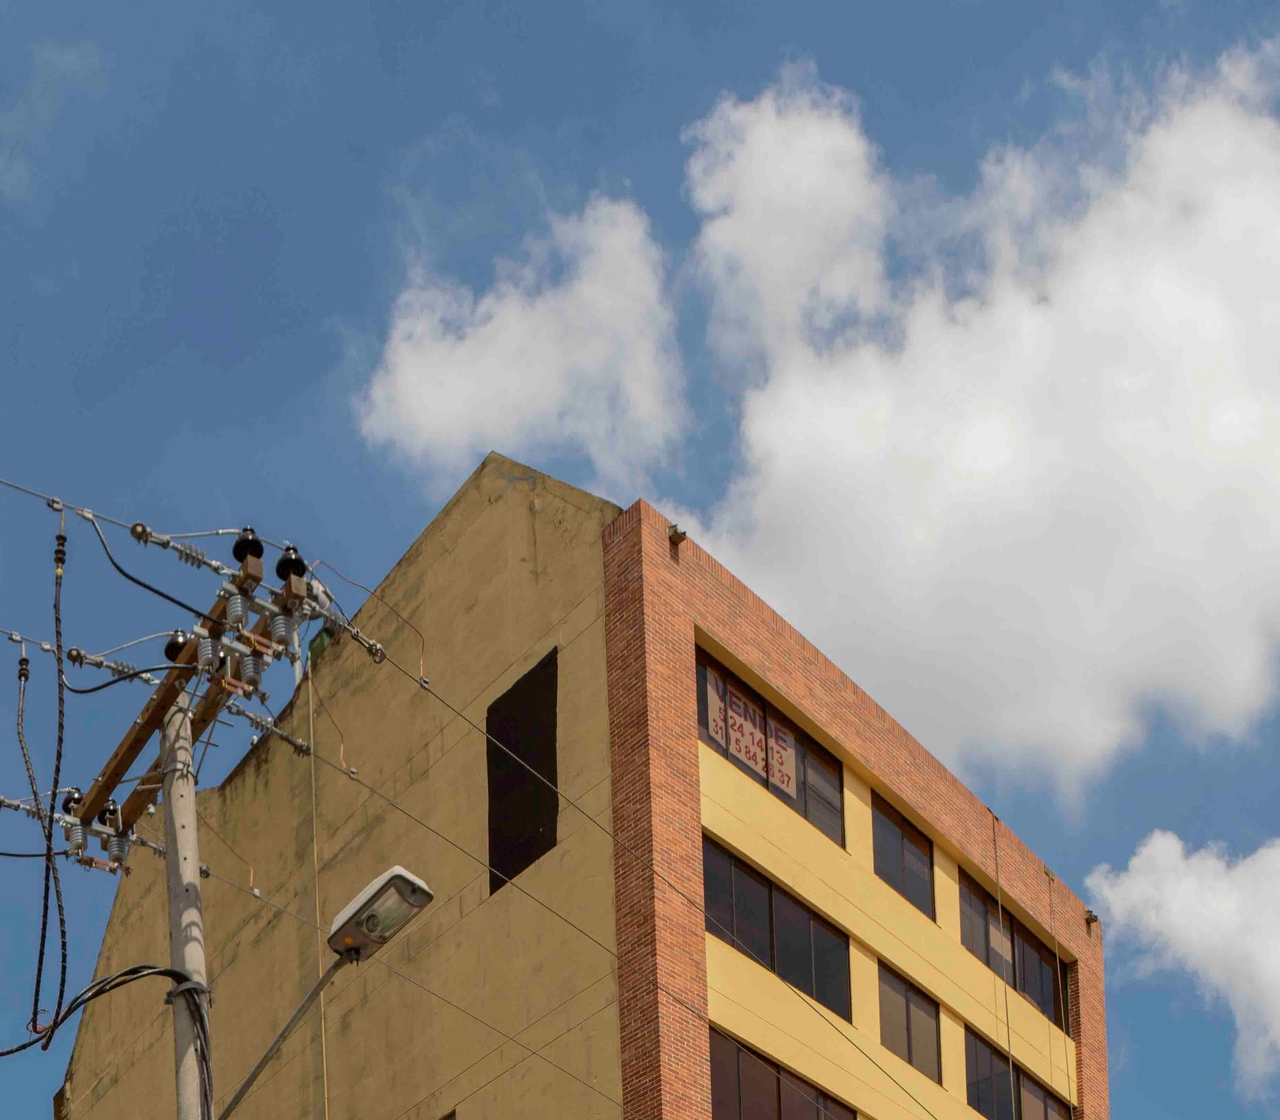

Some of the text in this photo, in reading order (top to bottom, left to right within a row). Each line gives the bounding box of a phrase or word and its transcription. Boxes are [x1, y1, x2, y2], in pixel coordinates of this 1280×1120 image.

[713, 674, 788, 752] VENDE
[730, 715, 745, 737] 24
[749, 731, 765, 752] 14
[769, 745, 784, 766] 13
[734, 738, 742, 754] 5
[745, 744, 759, 767] 84
[778, 769, 791, 788] 37
